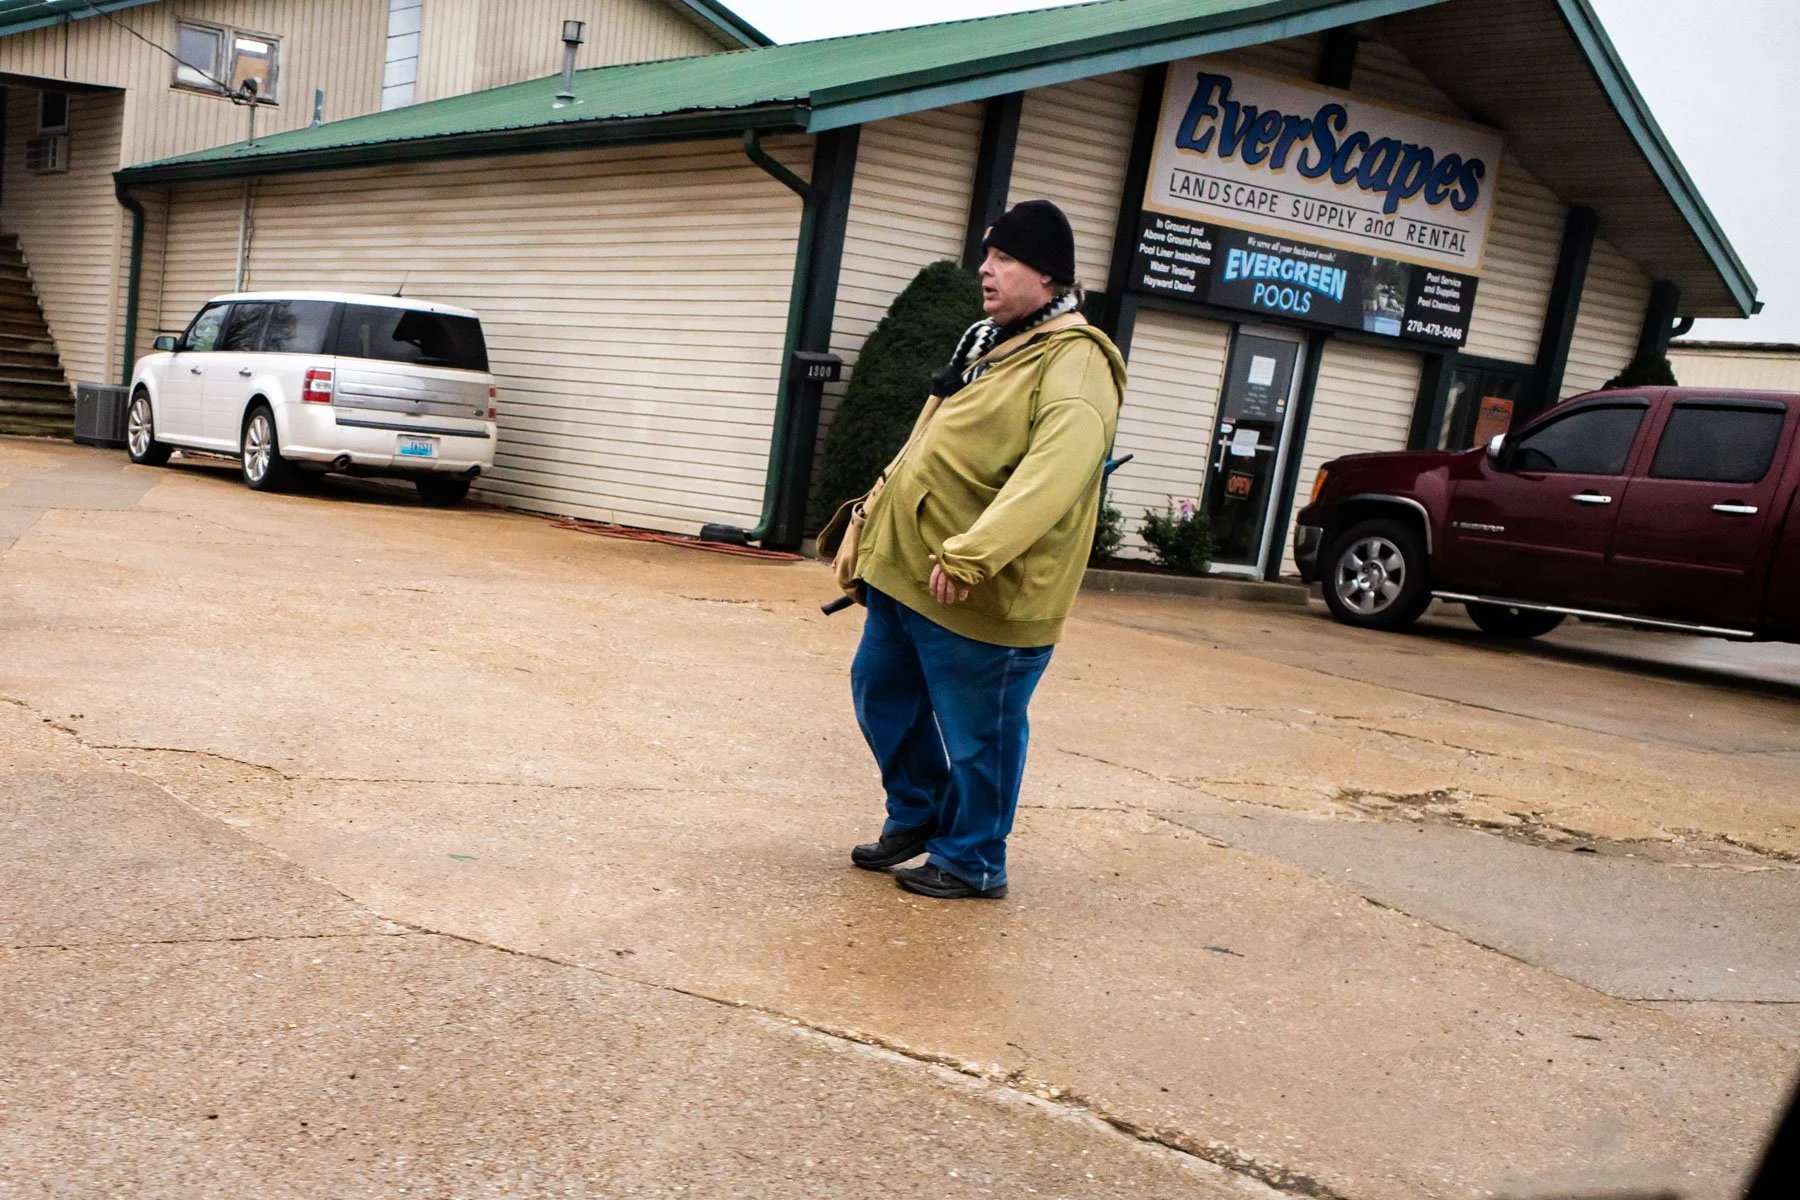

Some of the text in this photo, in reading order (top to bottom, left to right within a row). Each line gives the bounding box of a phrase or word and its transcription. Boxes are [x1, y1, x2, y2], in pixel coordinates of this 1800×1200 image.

[1175, 71, 1486, 214] EverScapes
[1170, 172, 1467, 253] LANDSCAPE SUPPLY and RENTAL
[1156, 218, 1204, 236] In Ground and
[1143, 229, 1212, 250] Above Ground Pools
[1139, 243, 1211, 266] Pool Liner Installation
[1150, 260, 1196, 280] Water Testing
[1224, 248, 1347, 303] EVERGREEN
[1426, 272, 1462, 287] Pool Service
[1143, 274, 1196, 293] Hayward Dealer
[1423, 285, 1460, 298] and Supplies
[1252, 283, 1312, 314] POOLS
[1417, 296, 1460, 313] Pool Chemicals
